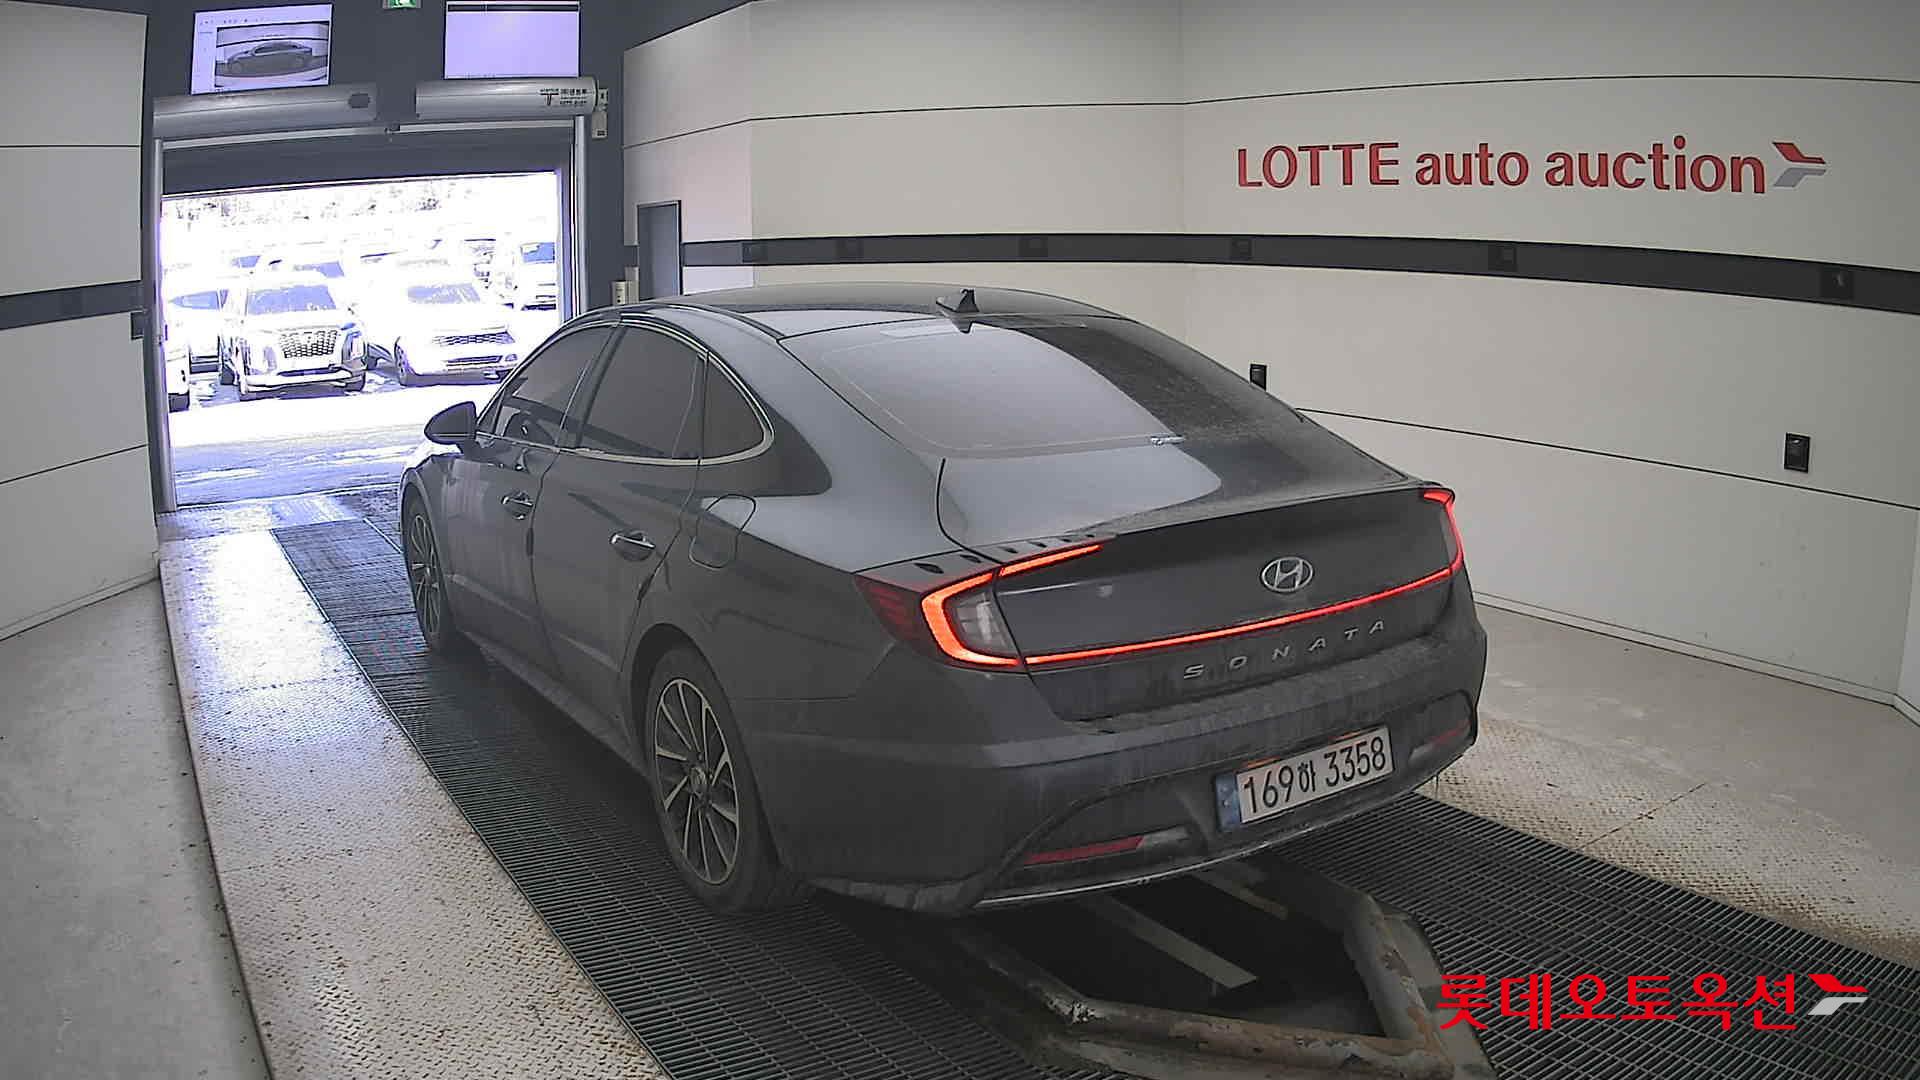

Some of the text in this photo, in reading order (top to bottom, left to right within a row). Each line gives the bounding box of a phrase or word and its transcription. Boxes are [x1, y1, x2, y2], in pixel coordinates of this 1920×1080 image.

[1238, 135, 1767, 194] LOTTE auto auction
[1183, 619, 1386, 679] SONATA
[1243, 736, 1387, 814] 169하 3358
